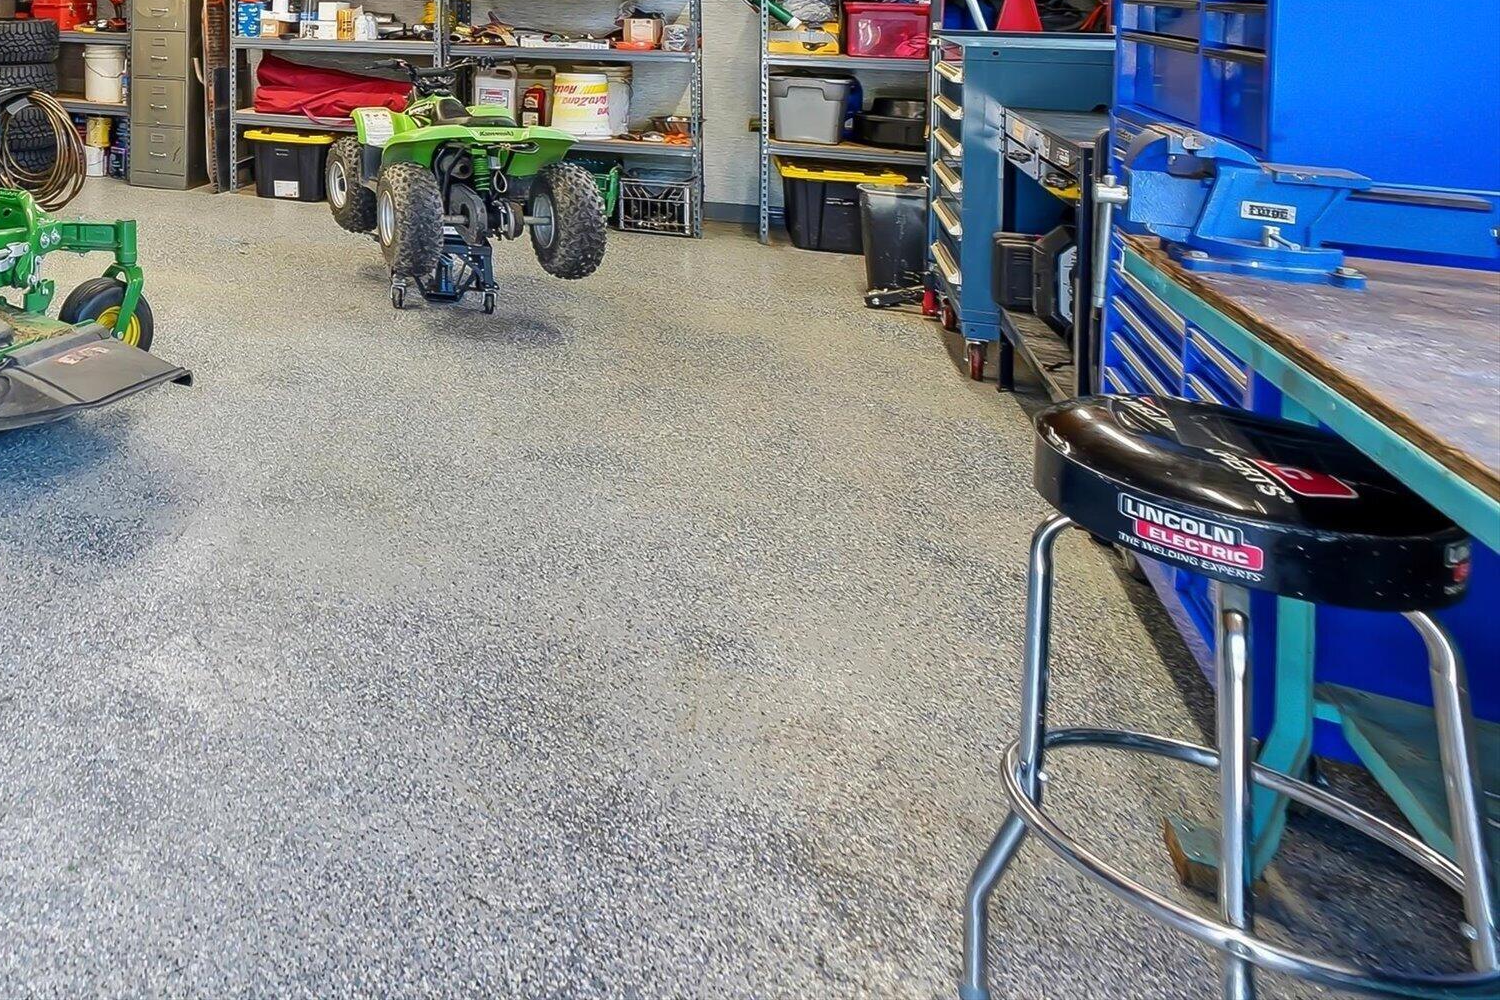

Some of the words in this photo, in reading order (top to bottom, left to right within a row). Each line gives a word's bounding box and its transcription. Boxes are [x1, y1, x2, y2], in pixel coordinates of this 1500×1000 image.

[1126, 498, 1235, 545] LINCOLN
[1117, 530, 1141, 547] THE
[1141, 541, 1199, 566] WELDING
[1200, 559, 1263, 582] EXPERTS
[1149, 528, 1249, 565] ELECTRIC
